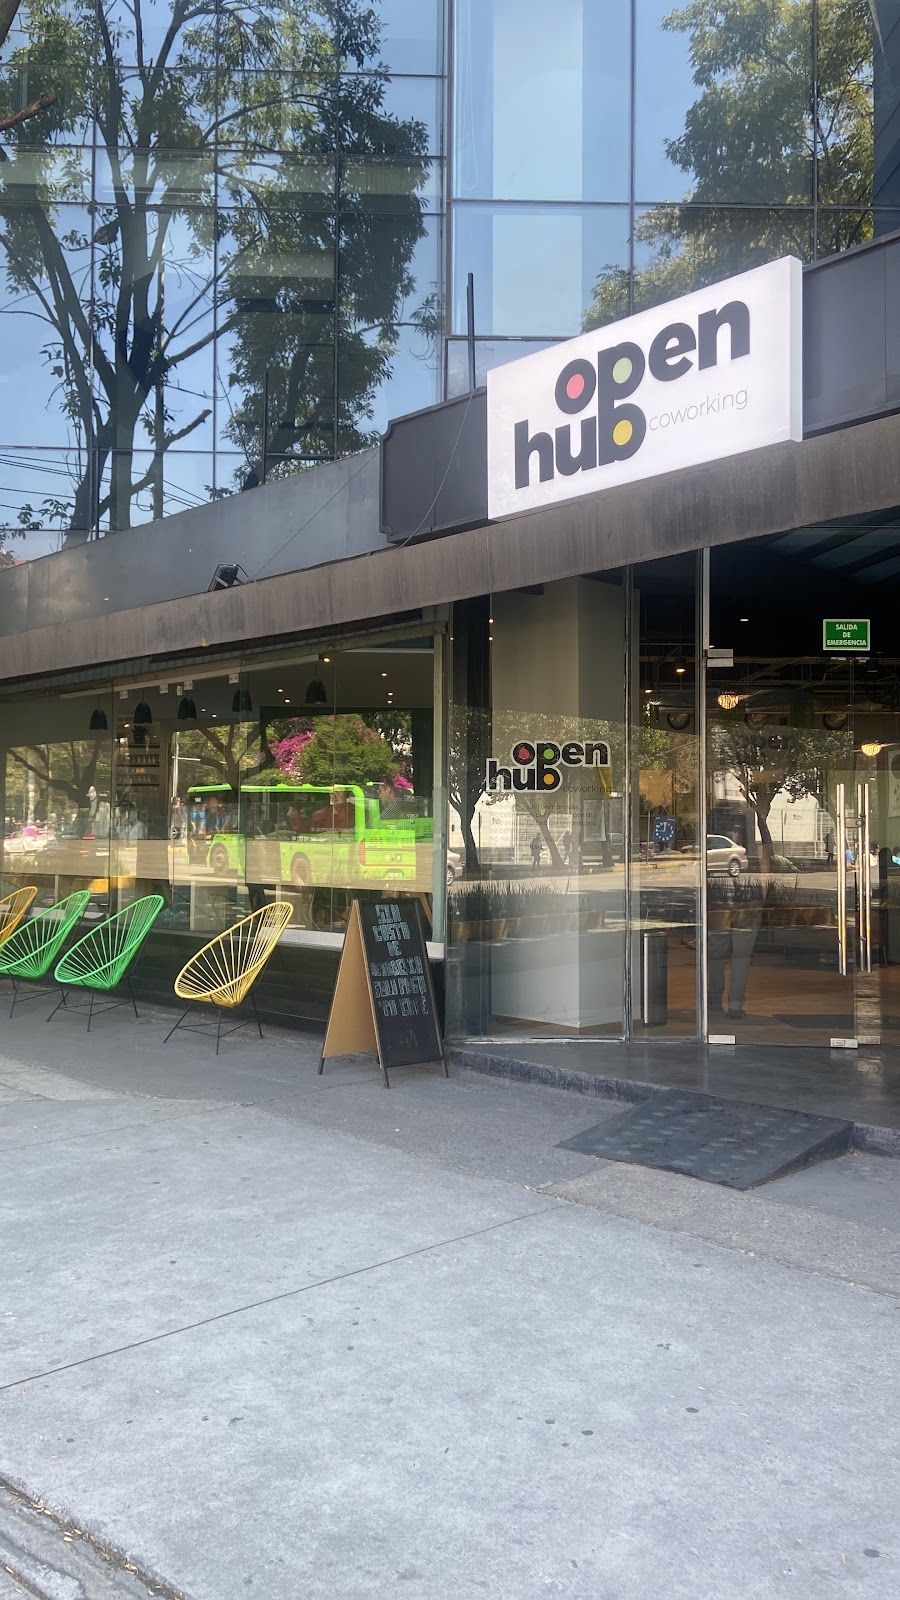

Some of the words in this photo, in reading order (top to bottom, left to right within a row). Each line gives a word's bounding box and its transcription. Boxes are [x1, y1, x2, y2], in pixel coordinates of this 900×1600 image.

[555, 300, 750, 414] open
[514, 403, 646, 489] hub
[649, 388, 748, 431] coworking
[512, 741, 609, 767] open
[486, 758, 562, 793] hub
[375, 904, 401, 924] SIN
[372, 922, 410, 942] COSTO
